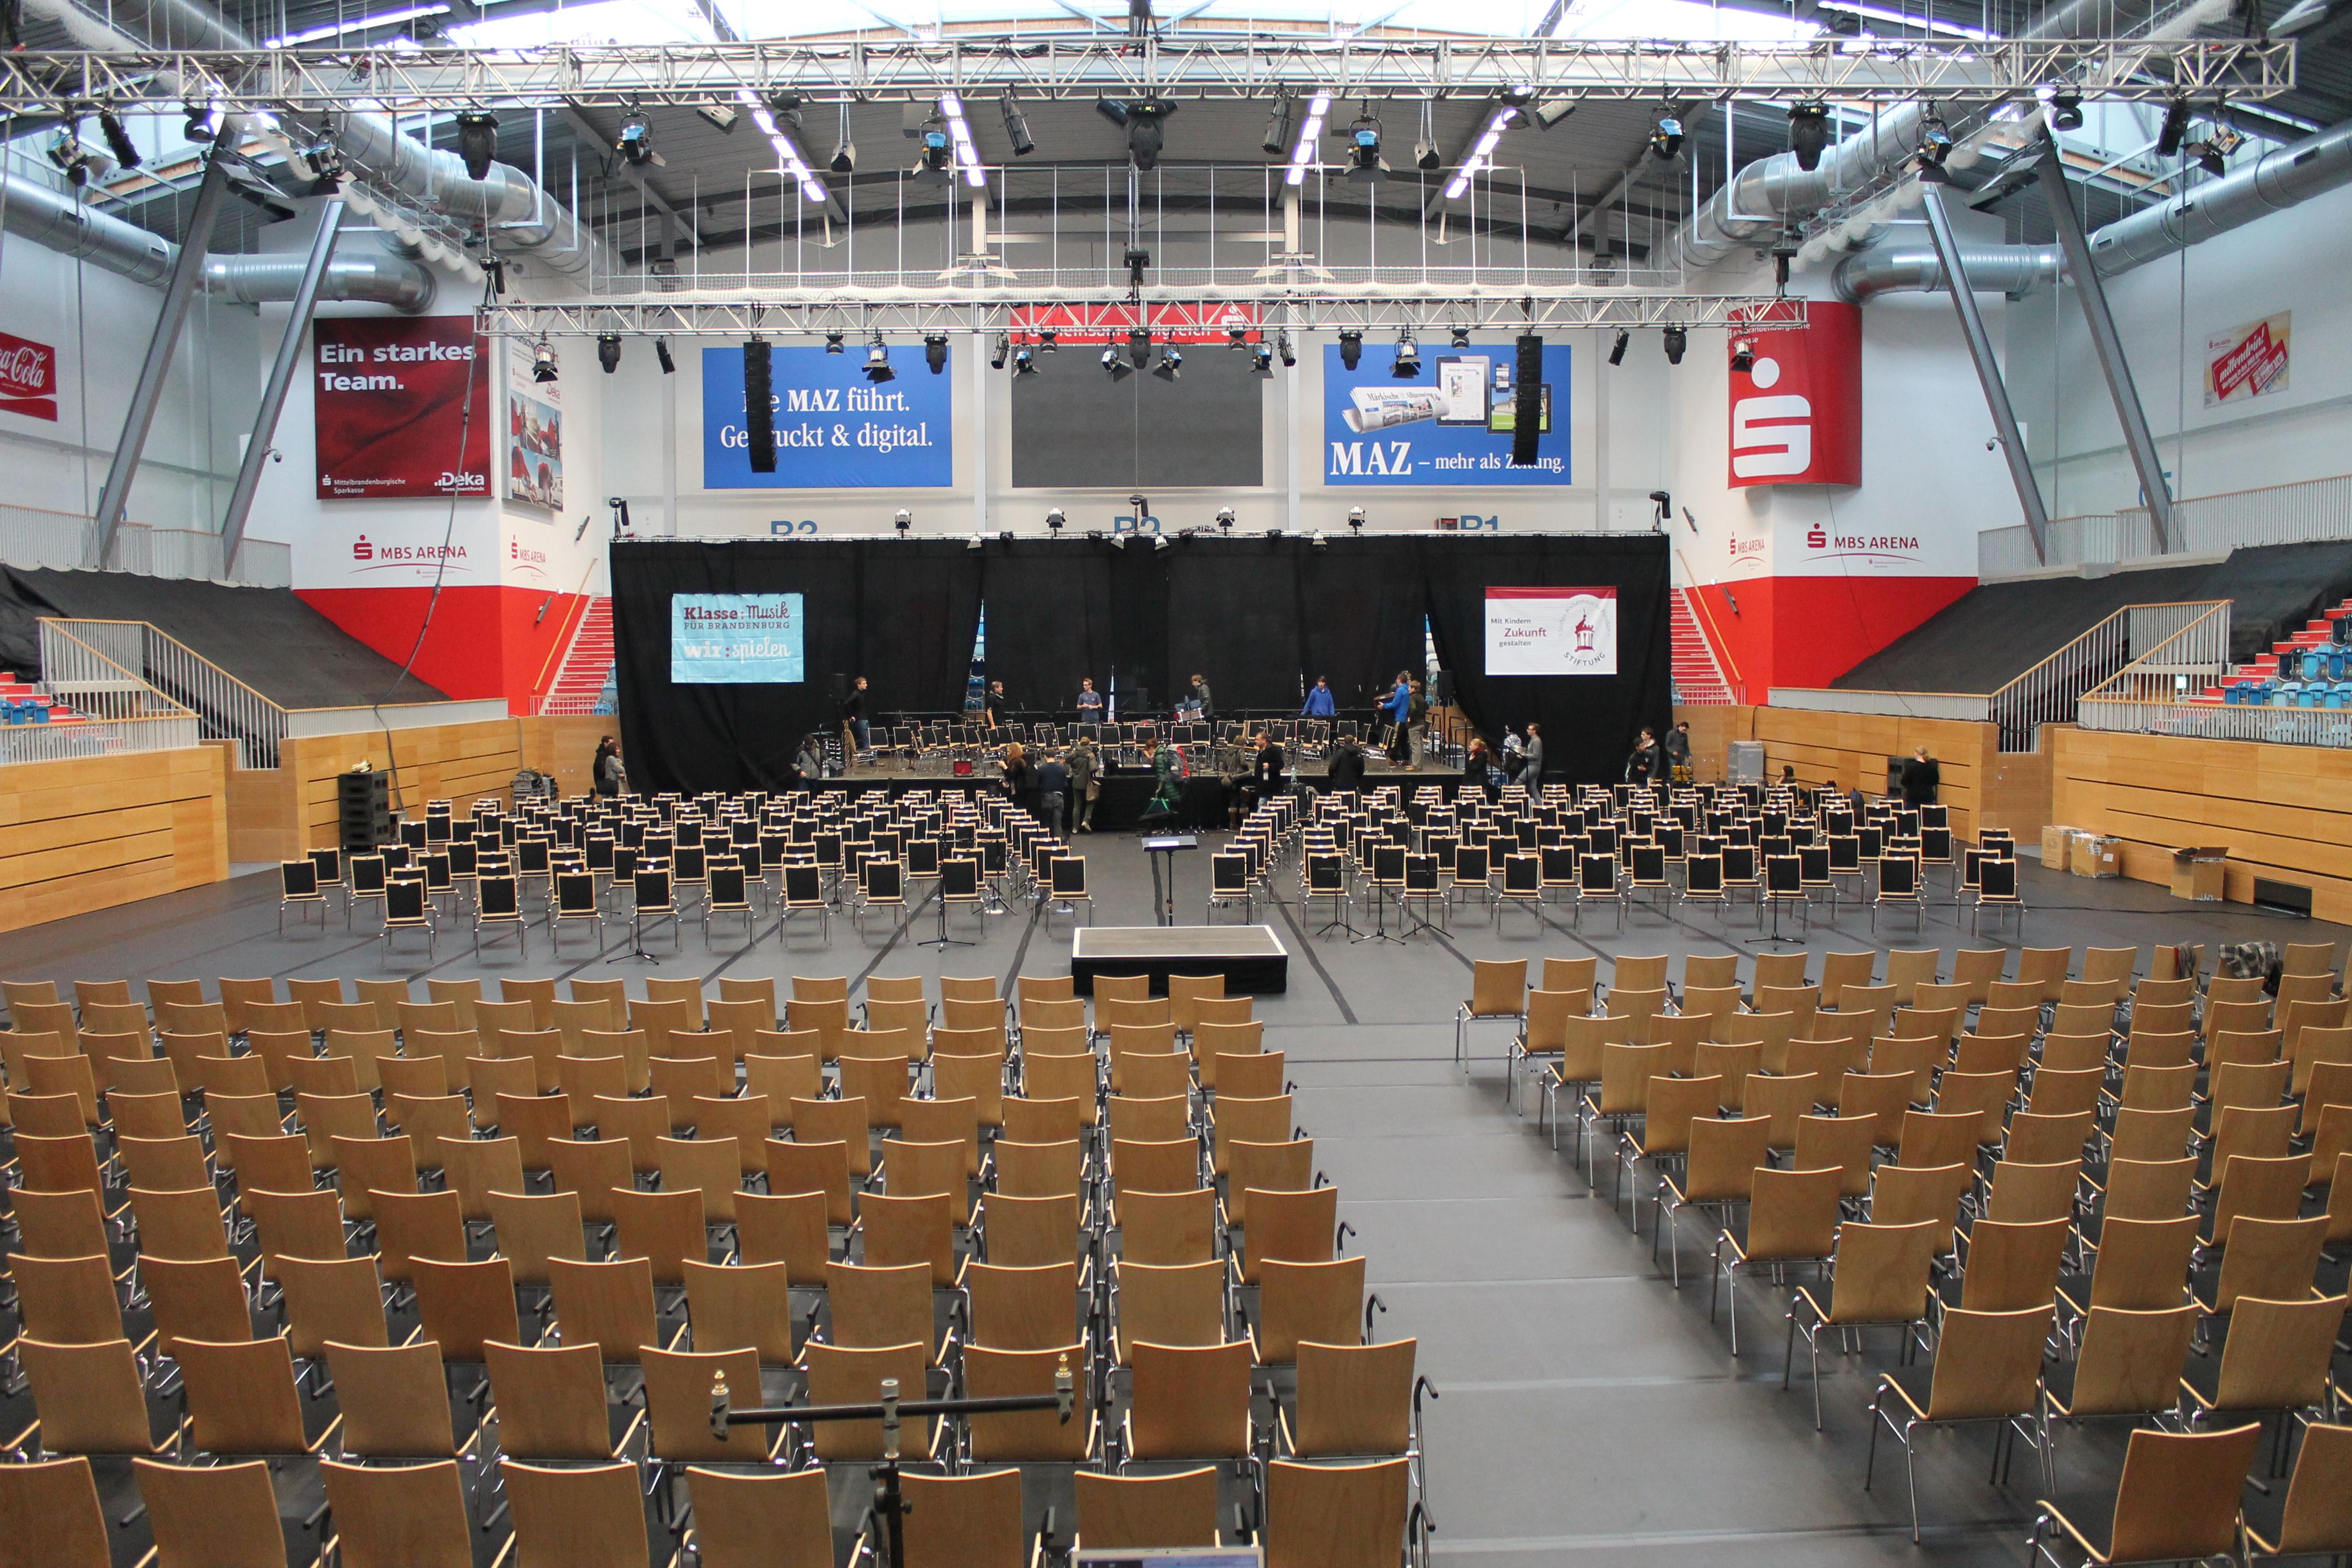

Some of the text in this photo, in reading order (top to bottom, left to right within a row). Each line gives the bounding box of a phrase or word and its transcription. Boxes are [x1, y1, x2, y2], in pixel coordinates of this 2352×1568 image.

[321, 341, 476, 363] Ein starkes
[320, 373, 404, 391] Team.
[787, 390, 840, 412] MAZ
[847, 386, 910, 412] führt.
[721, 422, 933, 453] Geuckt & digital.
[1330, 441, 1412, 476] MAZ
[1435, 453, 1475, 470] mehr
[1480, 453, 1501, 469] als
[1505, 453, 1565, 474] Zung.
[442, 472, 484, 486] Deka
[1738, 538, 1765, 554] MBS ARENA
[1834, 537, 1865, 549] MBS
[1869, 537, 1919, 549] ARENA
[381, 548, 412, 559] MBS
[416, 546, 467, 558] ARENA
[520, 549, 546, 563] MBS ARENA
[746, 601, 790, 619] Musik
[684, 620, 704, 630] FÜR
[1504, 628, 1547, 637] Zukunft
[732, 635, 791, 663] spielen
[1564, 652, 1606, 666] STIFTUNG
